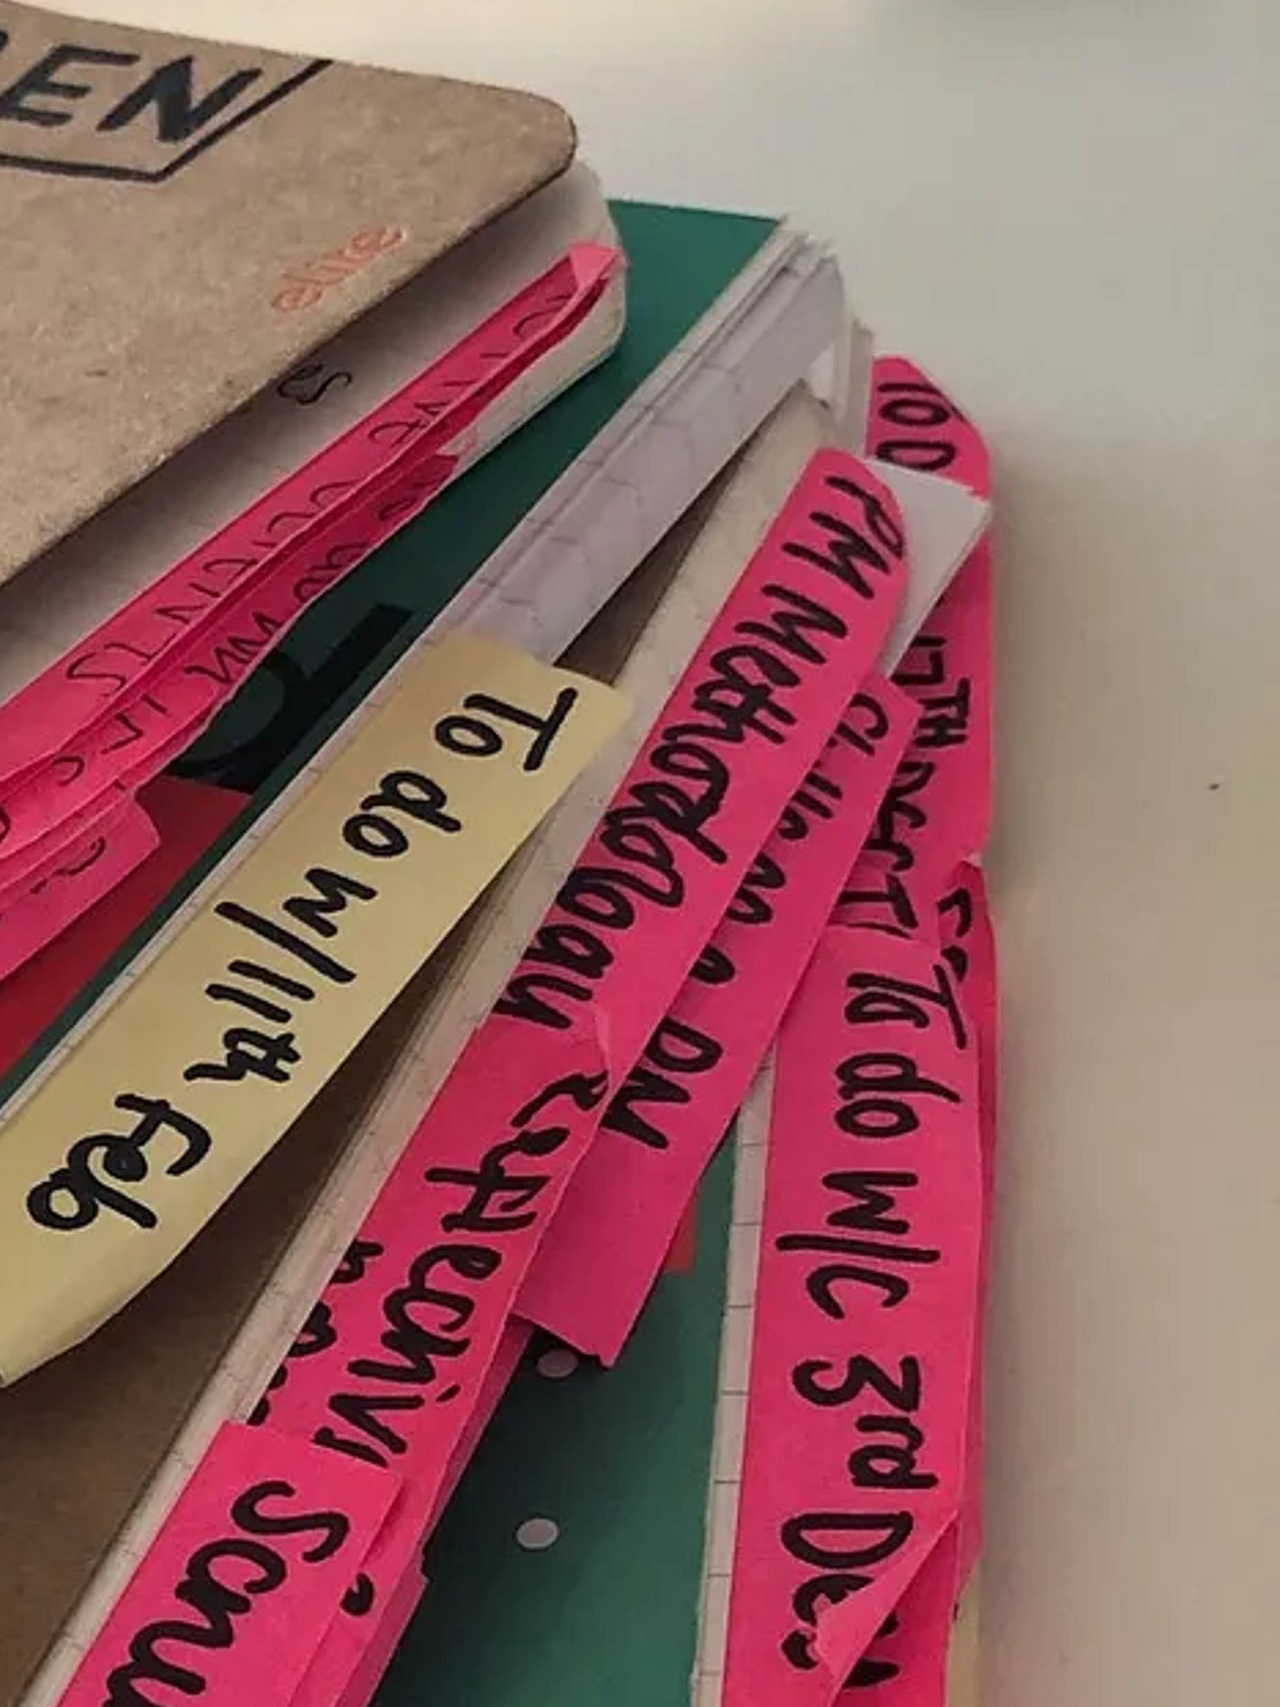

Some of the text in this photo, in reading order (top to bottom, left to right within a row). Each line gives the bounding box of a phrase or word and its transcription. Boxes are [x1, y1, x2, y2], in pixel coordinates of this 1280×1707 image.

[270, 225, 408, 313] elite
[783, 477, 905, 598] PM
[435, 688, 578, 771] To
[343, 771, 461, 857] do
[845, 965, 968, 1049] To
[834, 1053, 960, 1138] do
[27, 1094, 211, 1231] Feb
[775, 1171, 940, 1319] w/c
[792, 1355, 938, 1489] 3rd
